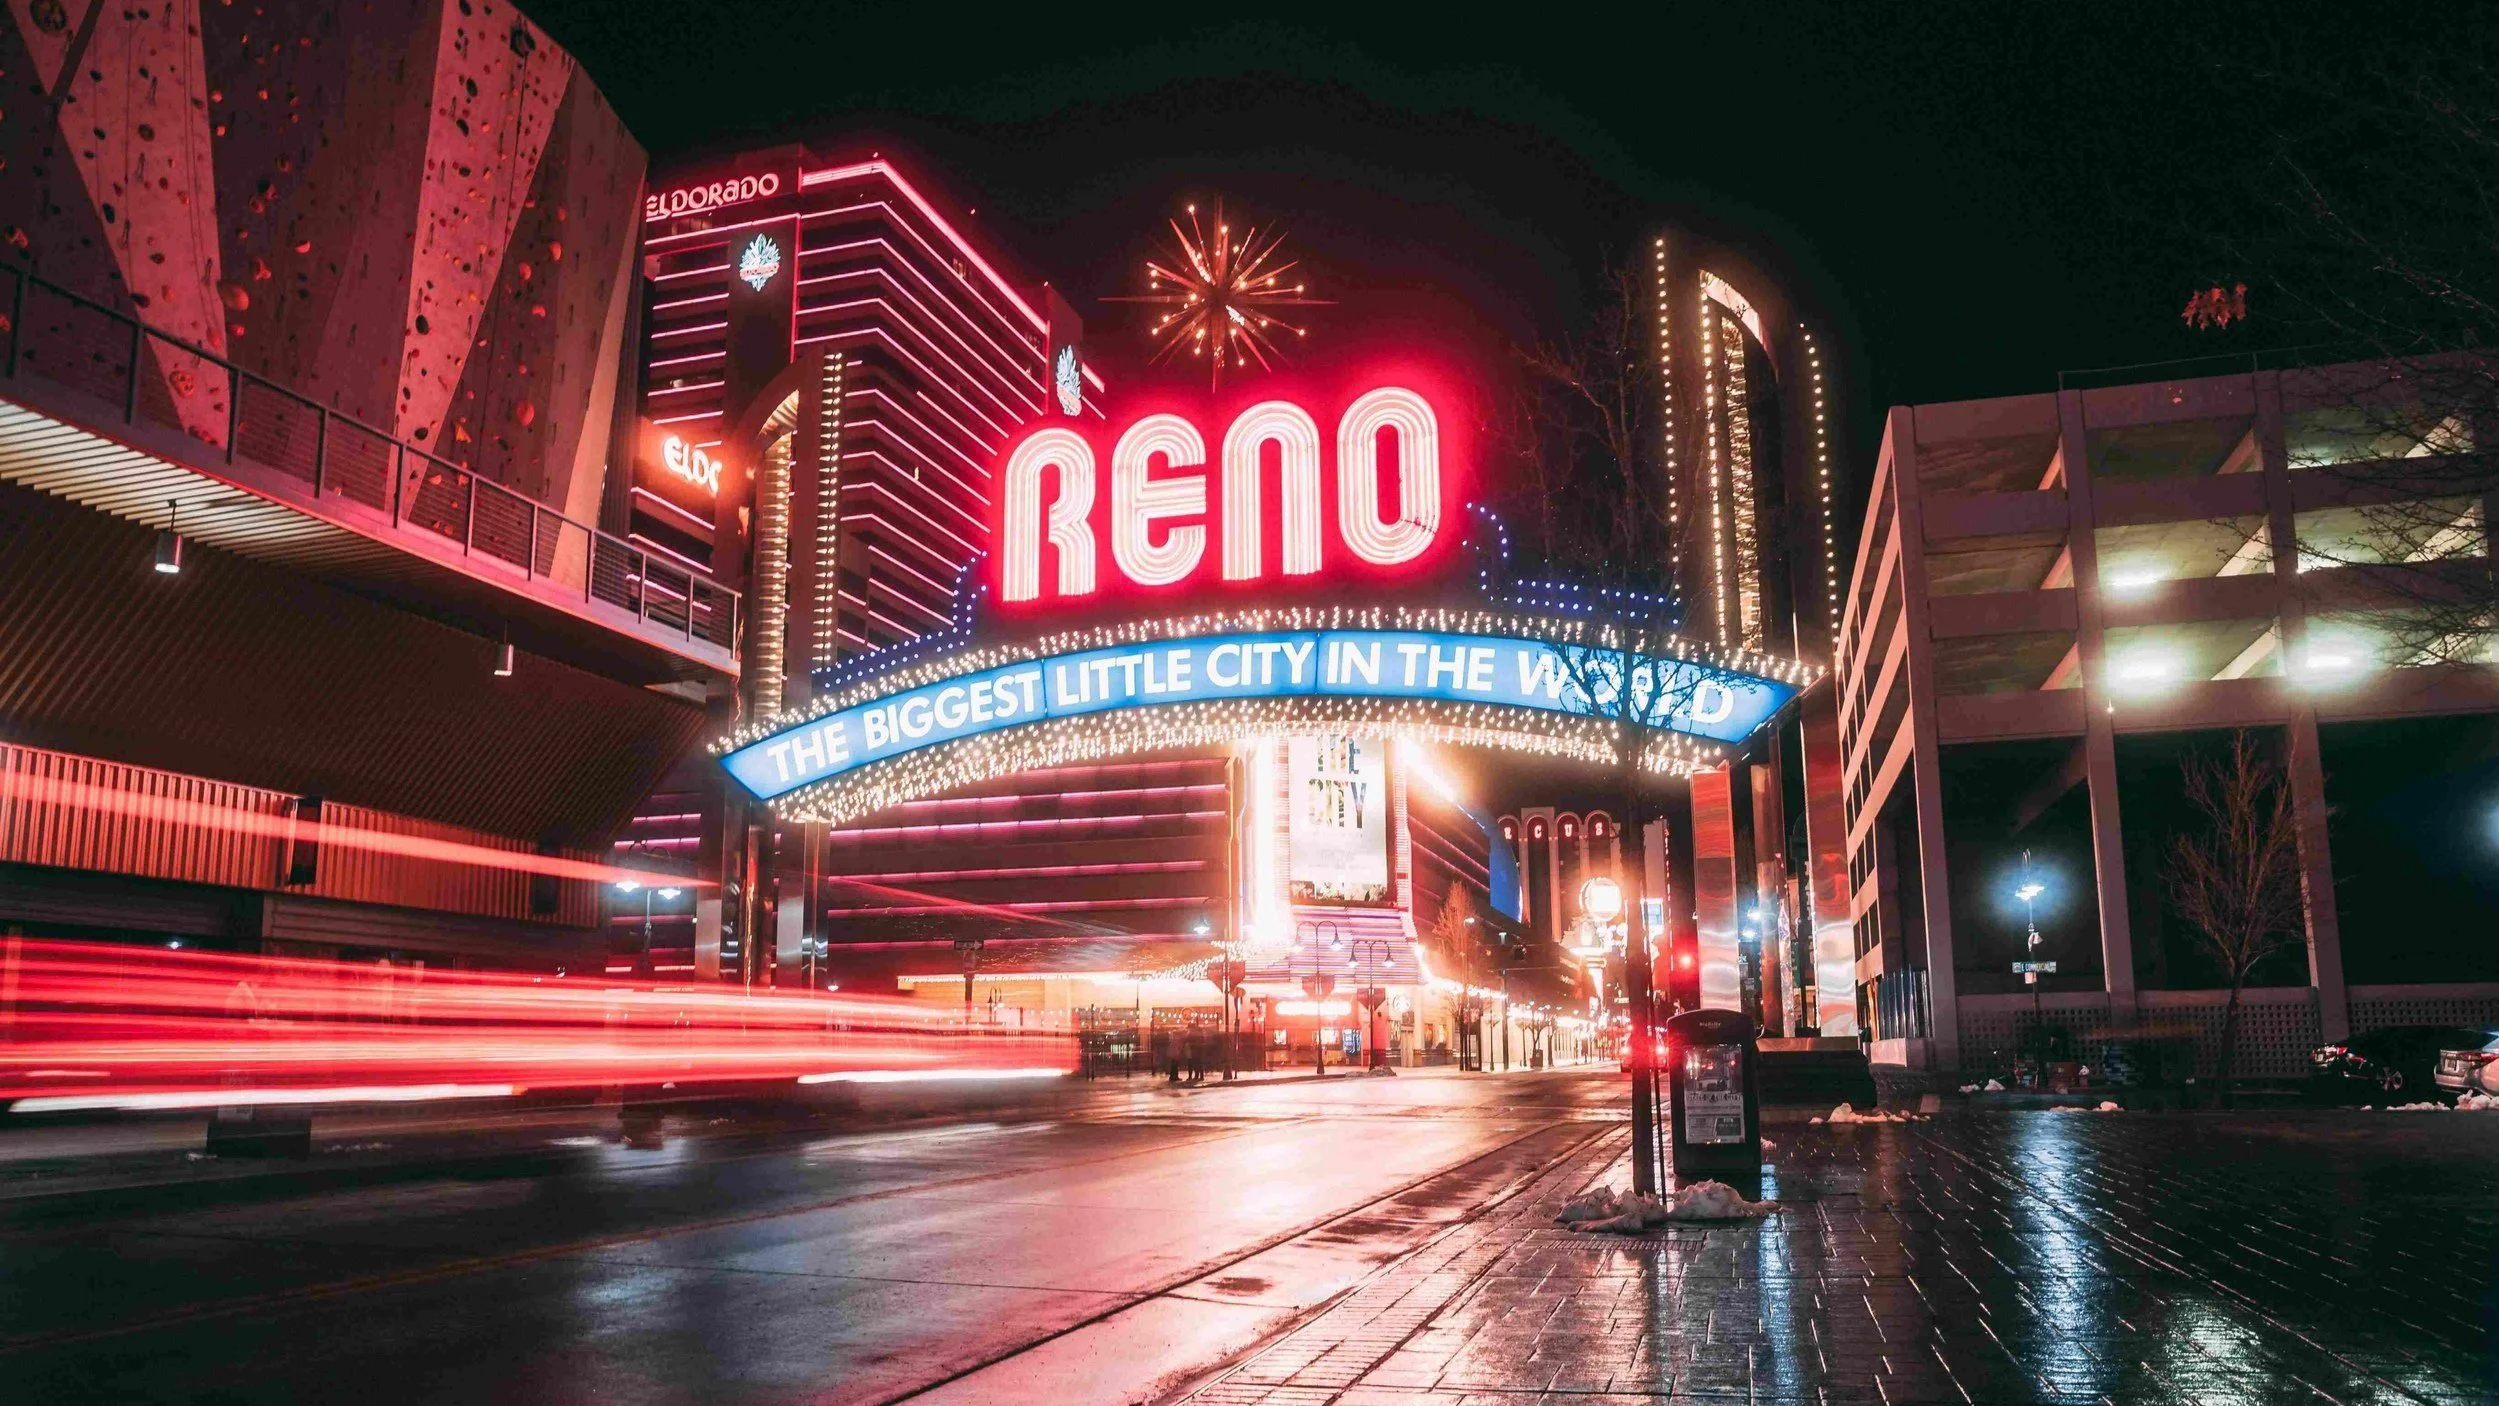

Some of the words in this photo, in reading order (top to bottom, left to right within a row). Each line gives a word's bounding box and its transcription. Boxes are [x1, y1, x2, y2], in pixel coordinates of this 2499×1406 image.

[1003, 387, 1440, 602] RENO
[767, 721, 849, 782] THE
[863, 670, 1041, 751] BIGGEST
[1056, 648, 1192, 706] LITTLE
[1206, 641, 1315, 688] CITY
[1326, 642, 1381, 685] IN
[1397, 642, 1496, 692] THE
